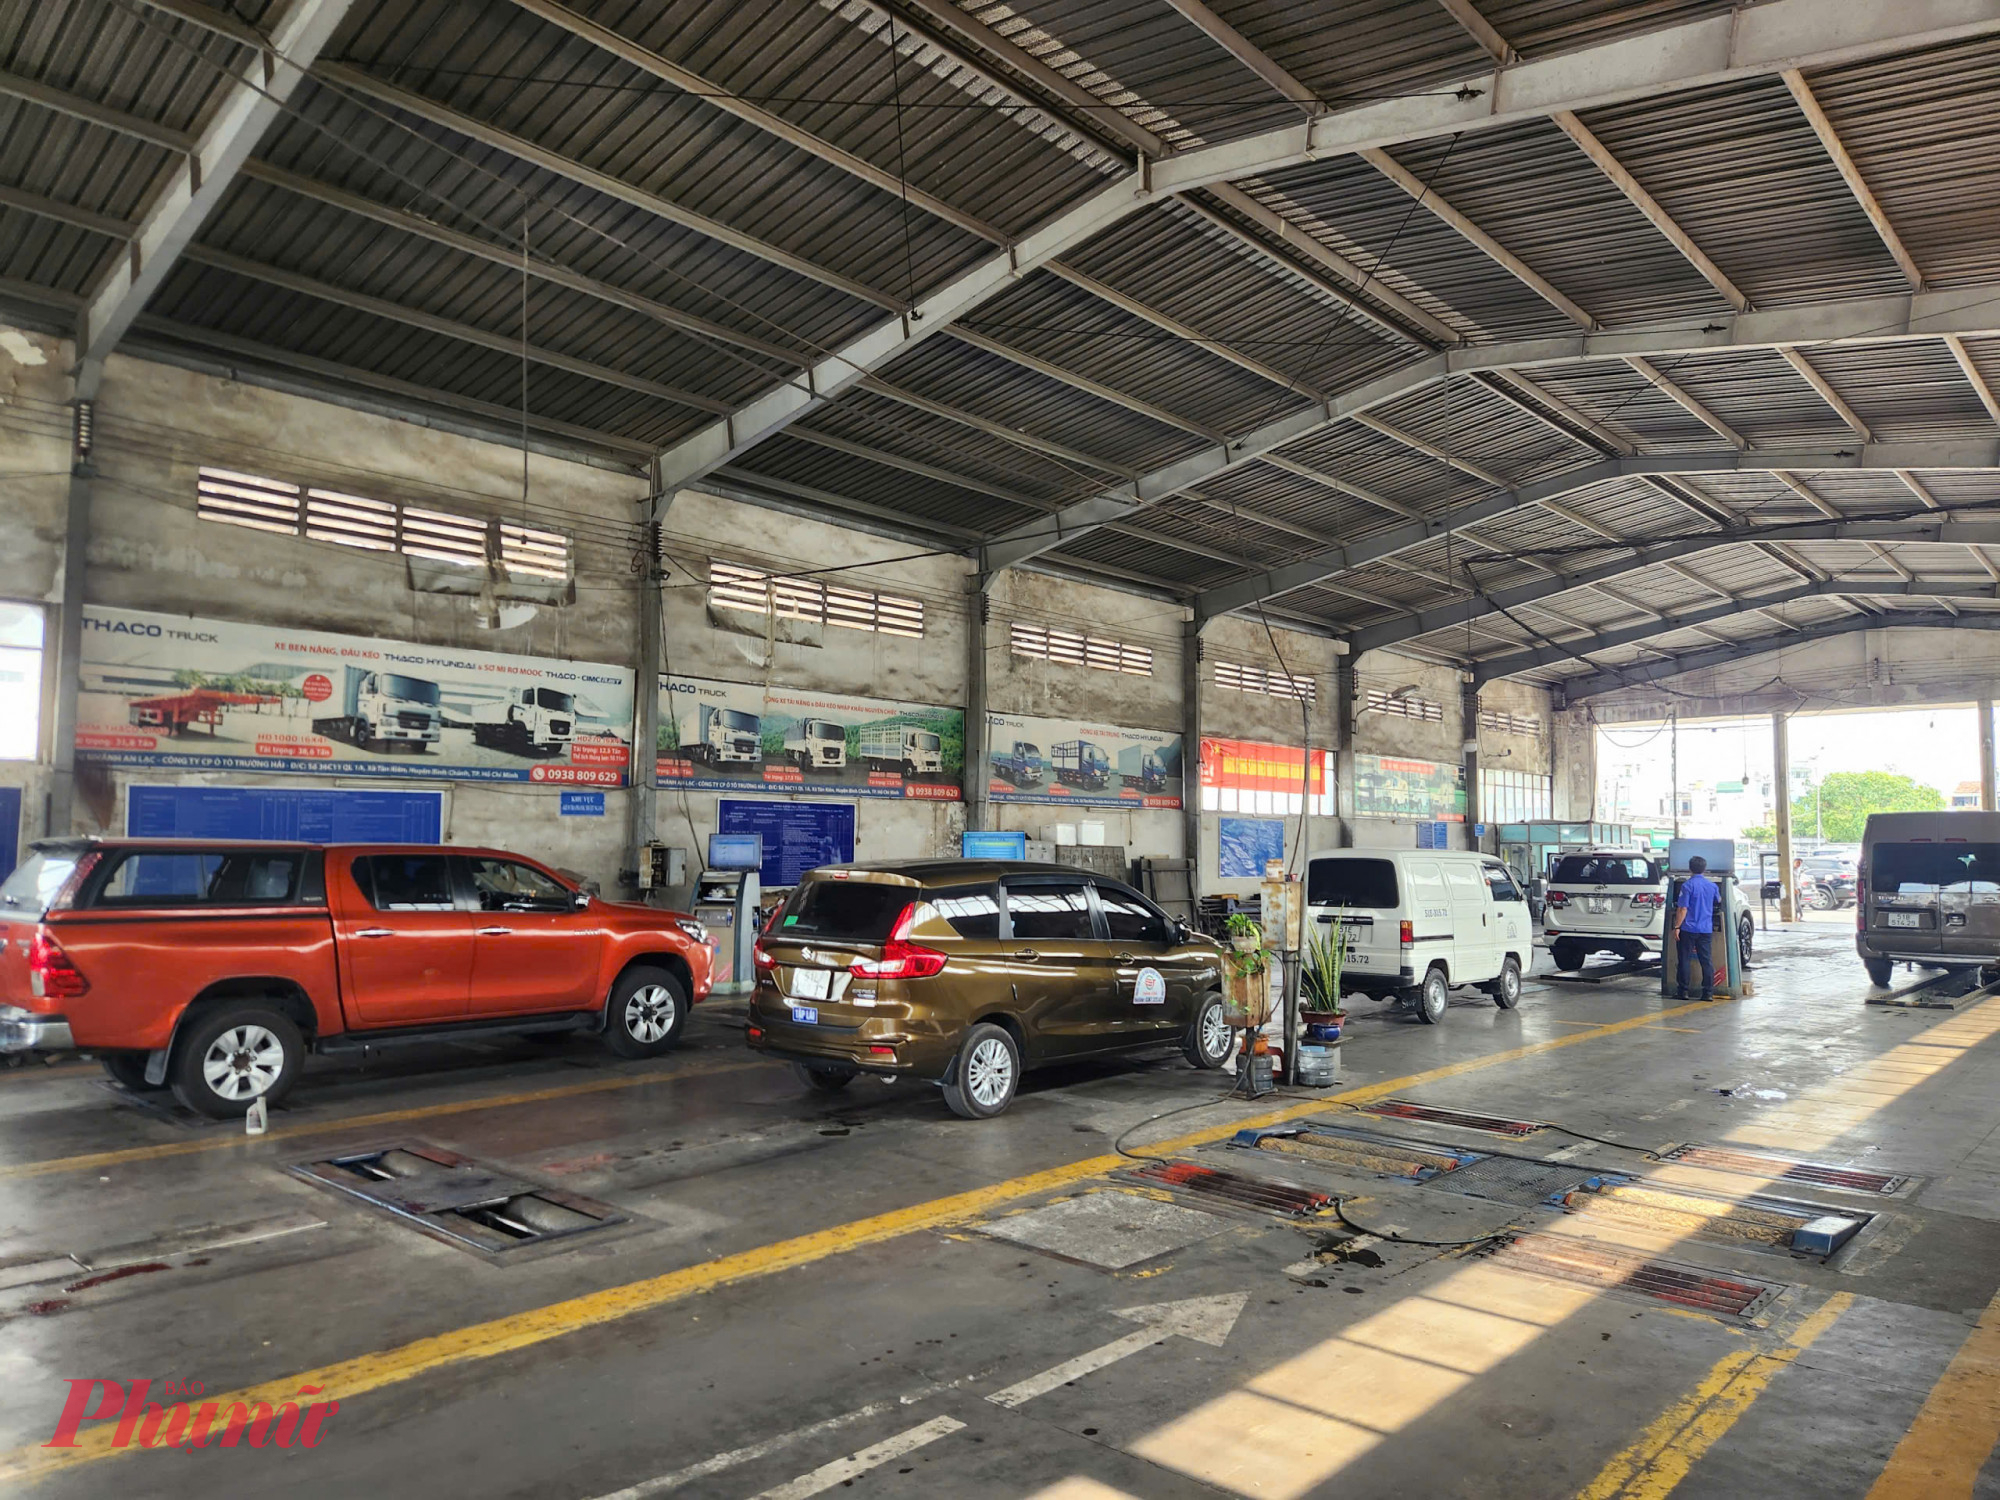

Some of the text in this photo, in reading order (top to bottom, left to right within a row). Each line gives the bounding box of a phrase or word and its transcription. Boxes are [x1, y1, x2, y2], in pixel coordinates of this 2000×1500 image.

[81, 617, 219, 643] THACO TRUCK
[384, 653, 424, 664] THACO
[426, 658, 476, 669] HYUNDAI
[546, 671, 576, 680] THACO
[698, 688, 727, 698] TRUCK
[548, 768, 617, 782] 0938 809 629
[916, 787, 958, 797] 0938 809 629
[1344, 954, 1370, 964] 15.72
